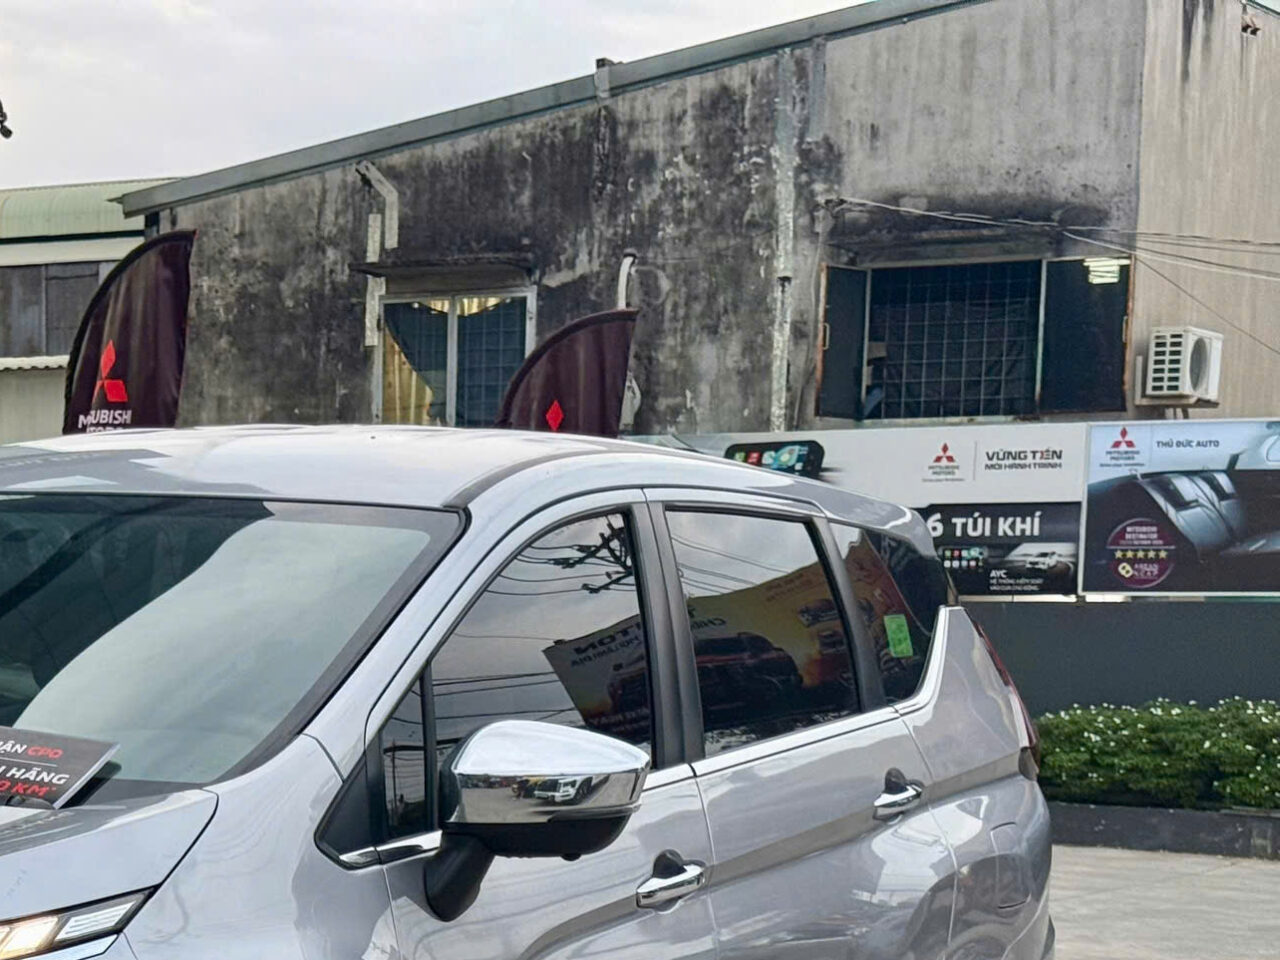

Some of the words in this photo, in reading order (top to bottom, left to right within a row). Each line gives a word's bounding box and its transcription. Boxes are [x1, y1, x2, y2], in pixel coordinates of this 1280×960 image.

[1195, 440, 1220, 448] AUTO
[926, 512, 944, 538] 6
[951, 511, 991, 537] TÚI
[998, 511, 1042, 537] KHÍ
[27, 745, 63, 759] CPO
[6, 767, 70, 785] HÃNG
